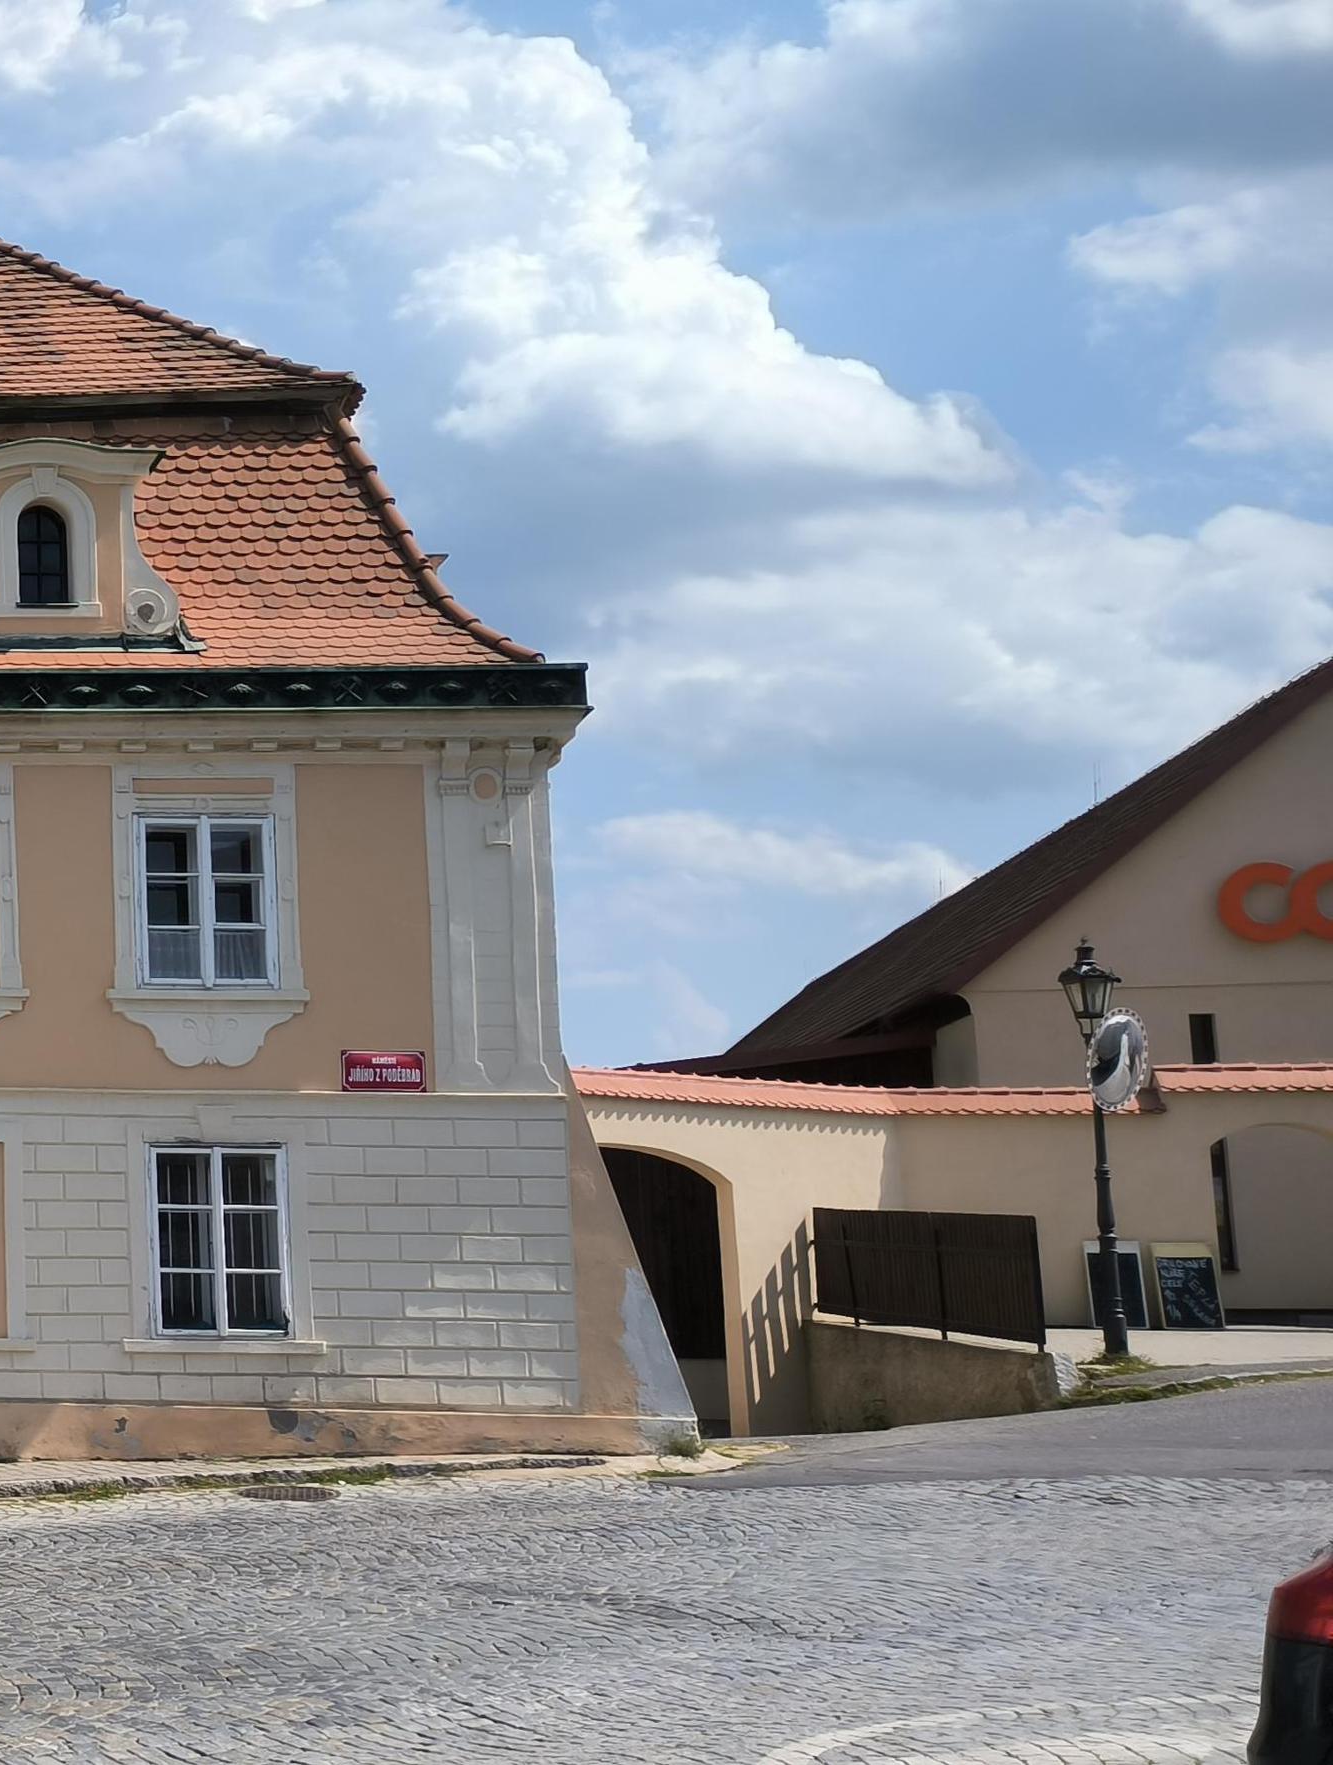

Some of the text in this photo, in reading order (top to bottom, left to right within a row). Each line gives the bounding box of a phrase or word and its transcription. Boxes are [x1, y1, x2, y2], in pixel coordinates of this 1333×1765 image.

[348, 1064, 421, 1083] JIŘÍHO Z PODĚBRAD
